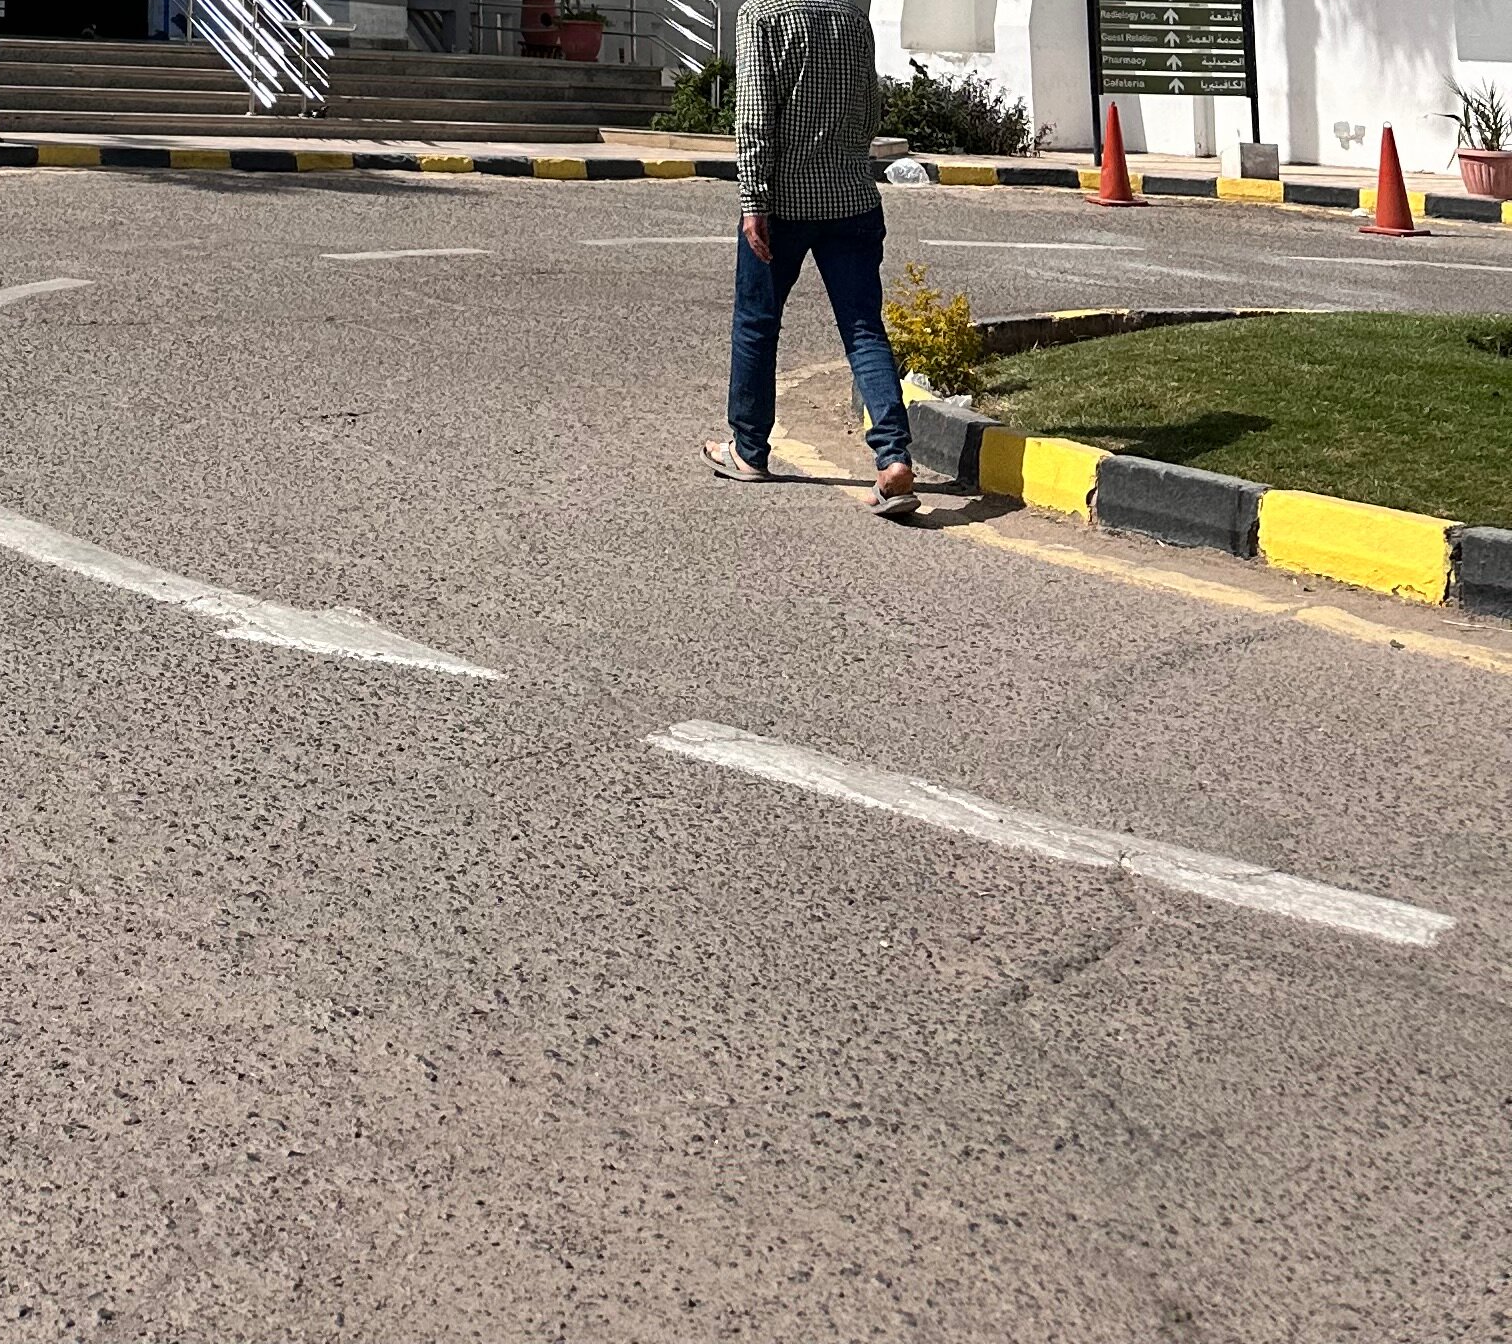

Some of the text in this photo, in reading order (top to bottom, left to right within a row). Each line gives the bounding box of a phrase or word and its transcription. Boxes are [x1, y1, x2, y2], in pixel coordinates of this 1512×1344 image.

[1100, 10, 1139, 21] Radiology
[1102, 55, 1146, 67] Pharmacy
[1201, 55, 1245, 69] الصيدلية
[1103, 78, 1145, 88] Cafeteria
